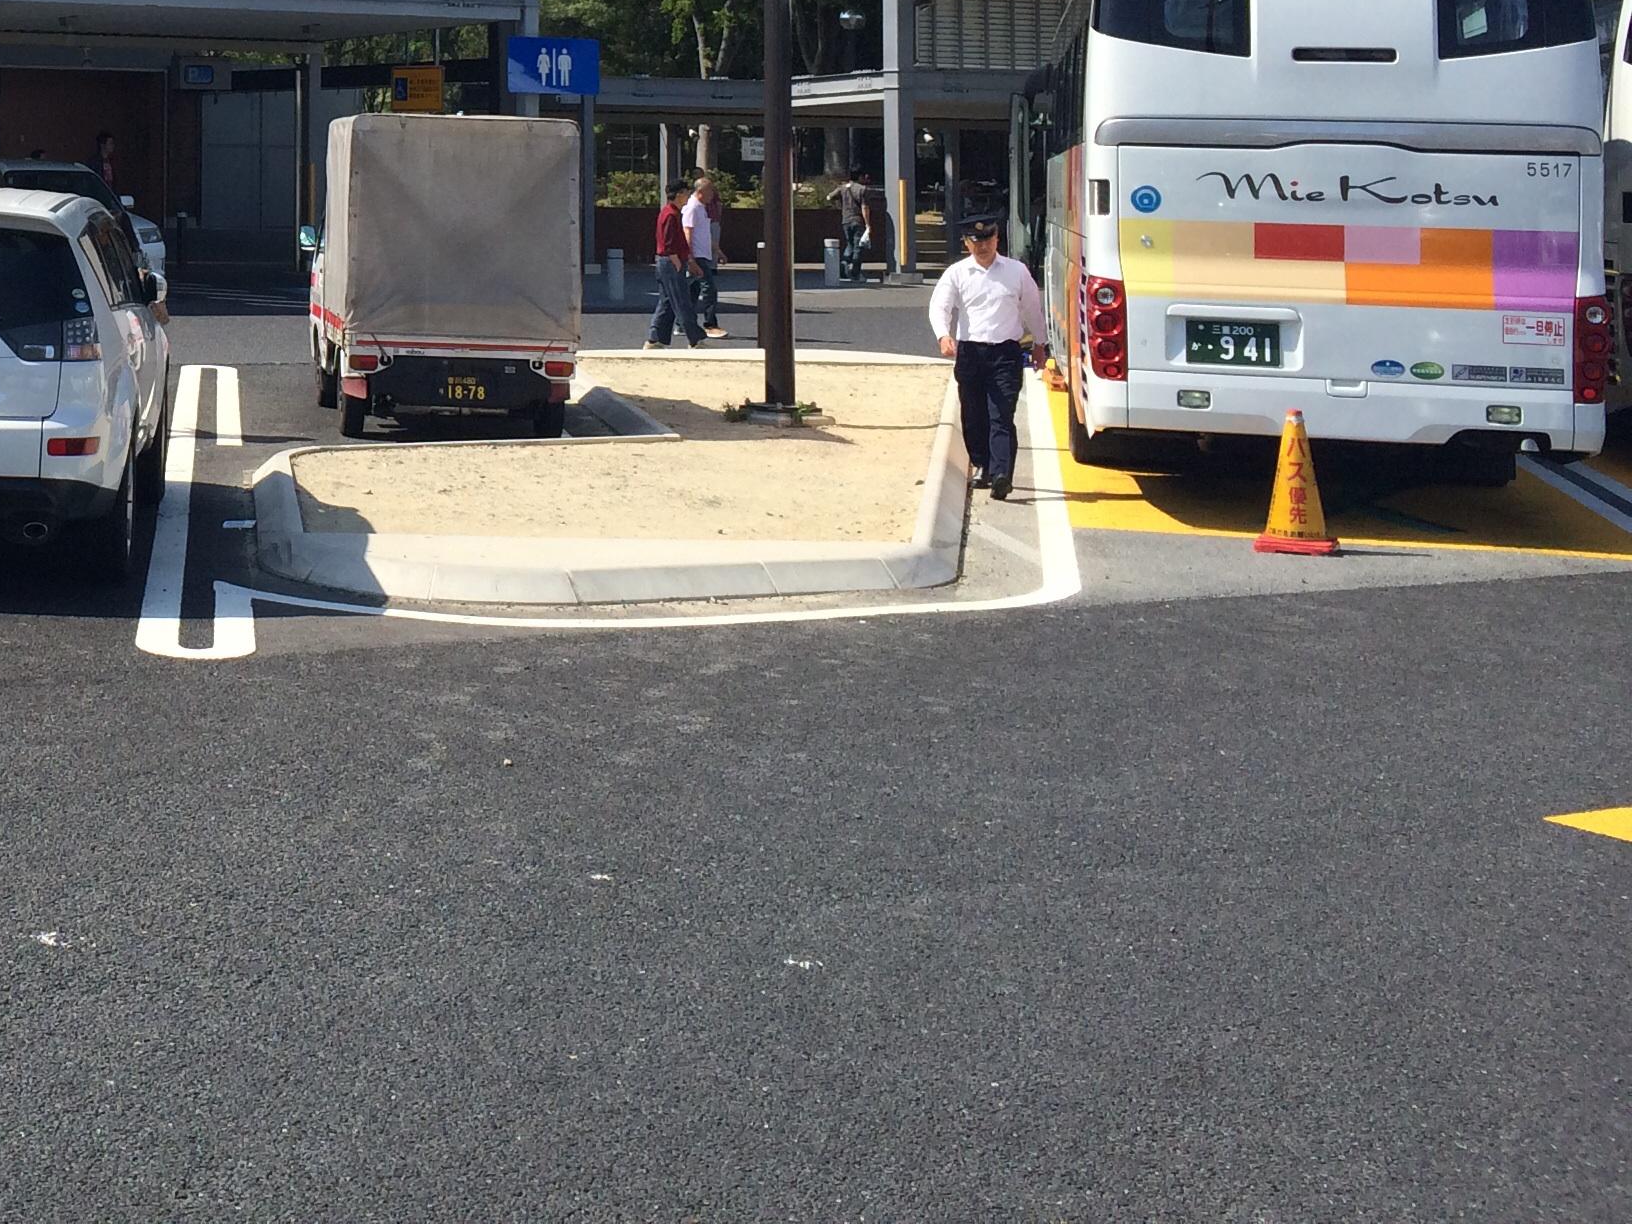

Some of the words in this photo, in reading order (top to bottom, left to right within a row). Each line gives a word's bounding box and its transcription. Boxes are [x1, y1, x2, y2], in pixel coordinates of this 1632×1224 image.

[1526, 162, 1573, 178] 5517
[1195, 171, 1325, 202] Mie
[1339, 174, 1499, 207] Kotsu
[447, 384, 486, 400] 18-78
